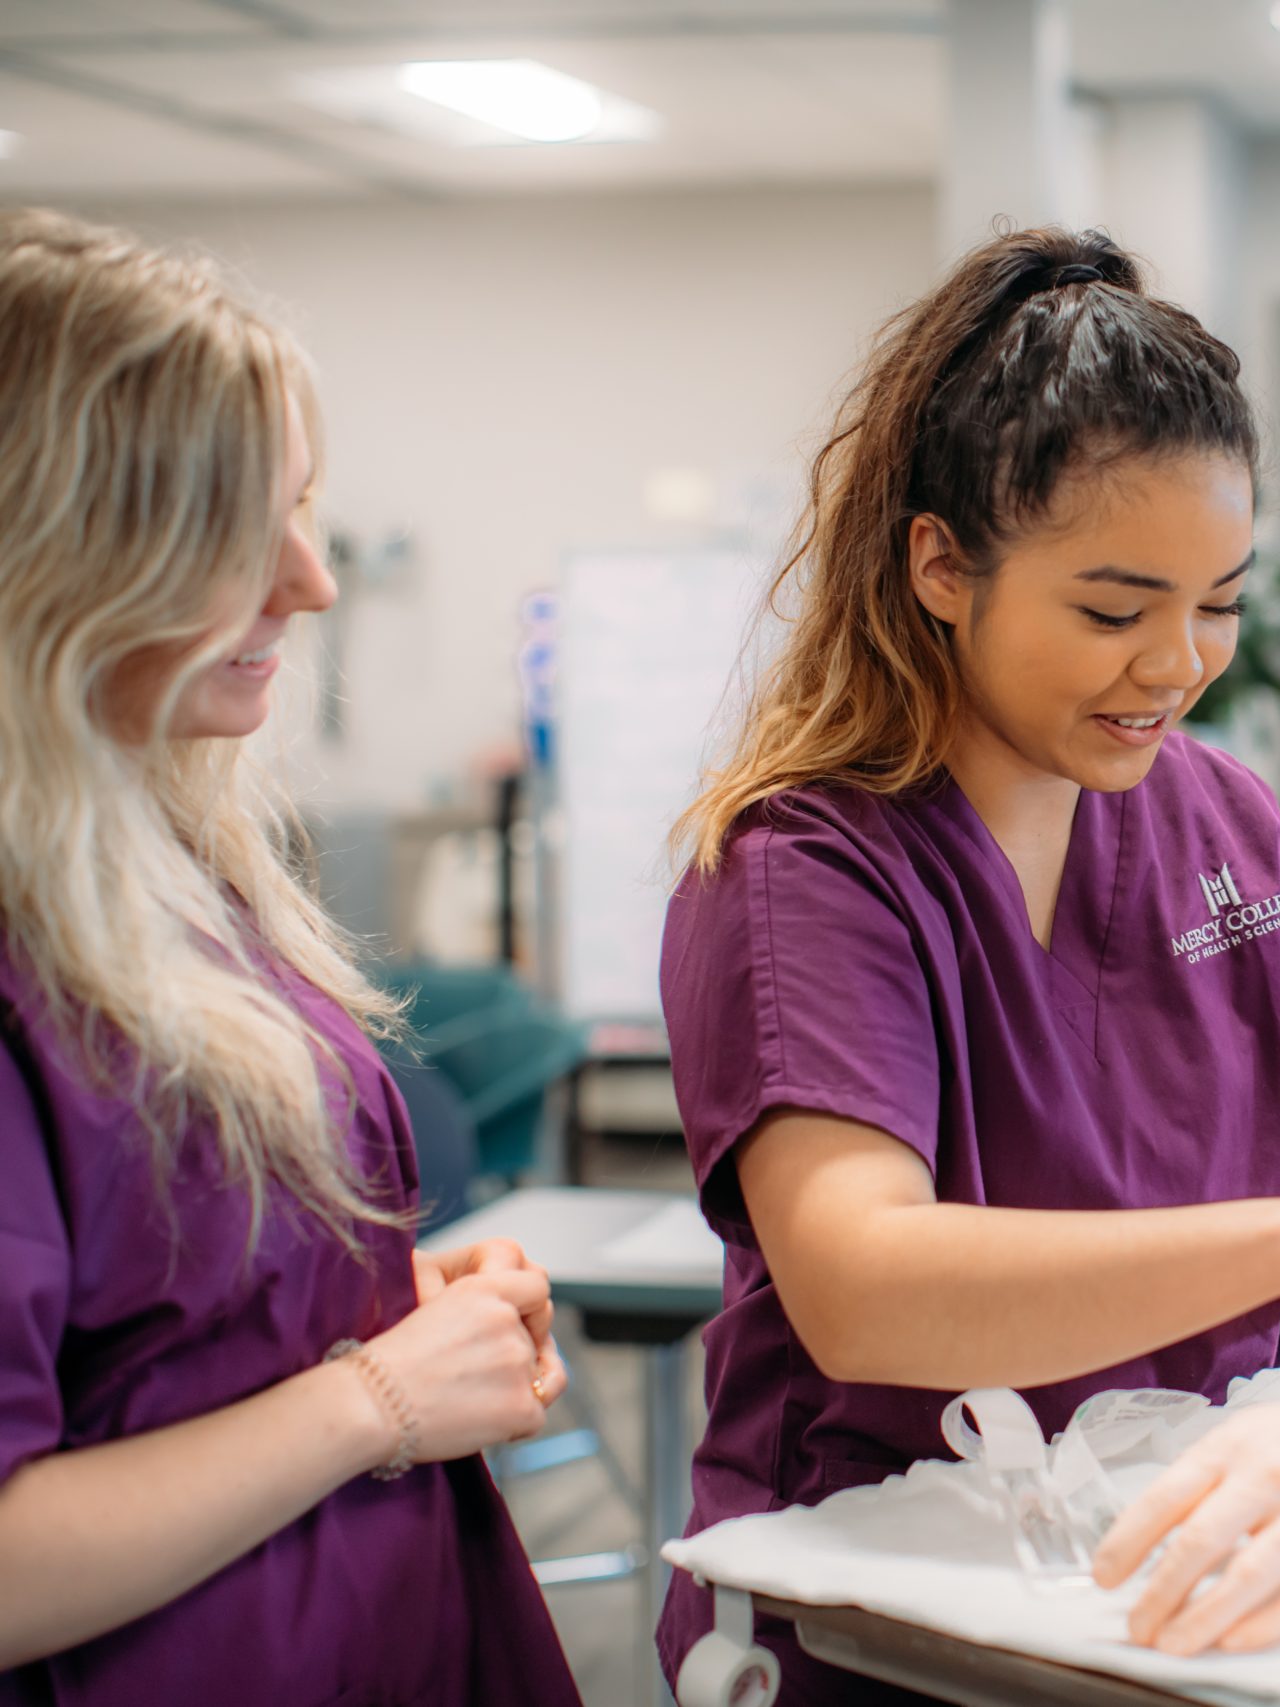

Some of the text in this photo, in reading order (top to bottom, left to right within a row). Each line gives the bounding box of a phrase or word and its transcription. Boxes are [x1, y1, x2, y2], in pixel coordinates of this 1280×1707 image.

[1171, 918, 1223, 957] MERCY
[1187, 951, 1201, 964] OF
[1202, 934, 1242, 959] HEALTH
